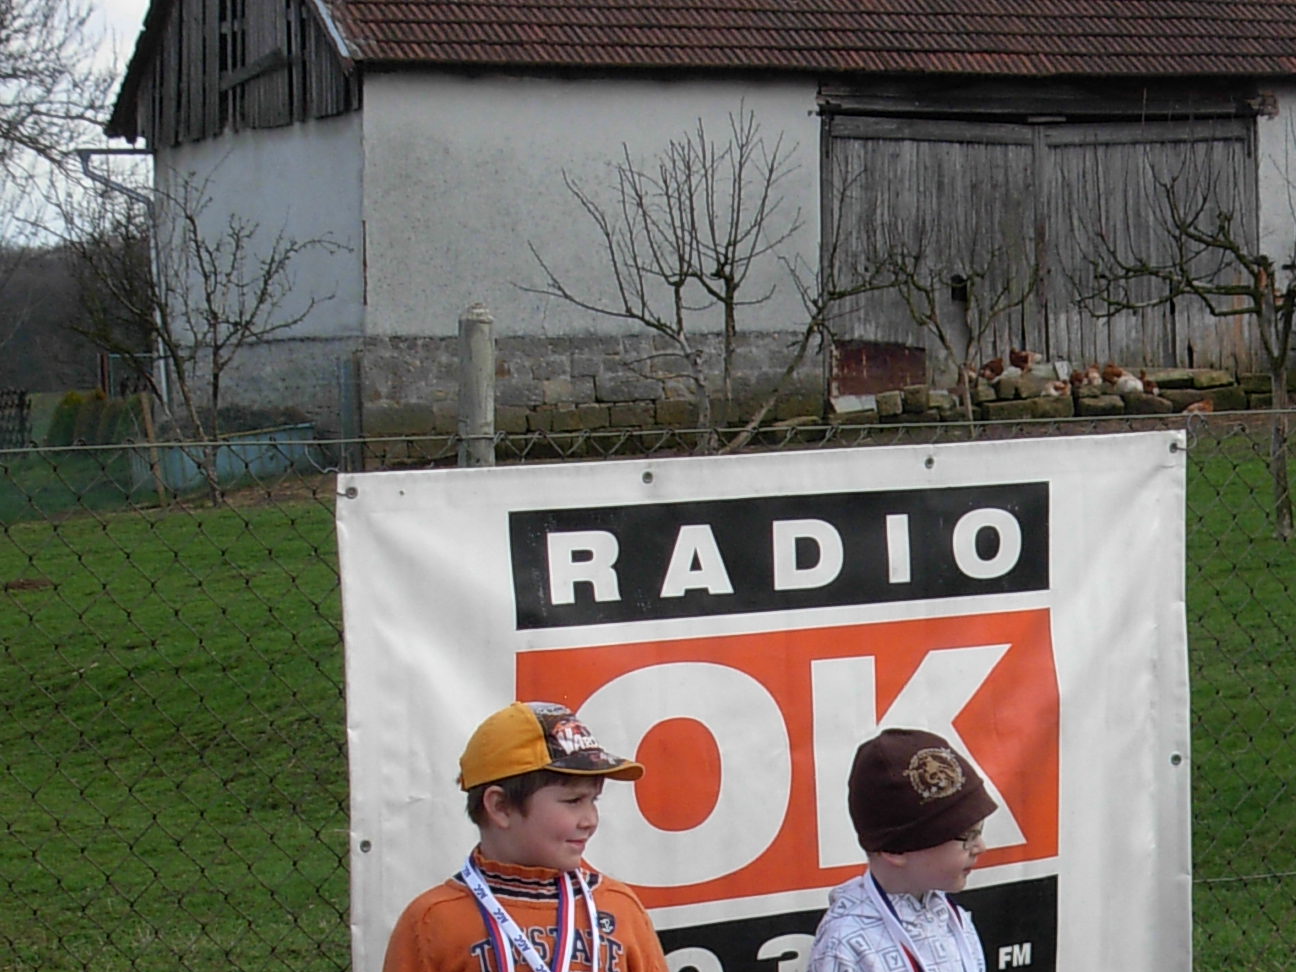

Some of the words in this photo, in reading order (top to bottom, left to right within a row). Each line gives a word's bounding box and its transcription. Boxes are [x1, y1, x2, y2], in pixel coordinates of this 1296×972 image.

[546, 507, 1023, 605] RADIO
[576, 643, 1026, 888] OK
[493, 908, 509, 924] AGC
[514, 934, 530, 952] AGC
[998, 942, 1032, 970] FM
